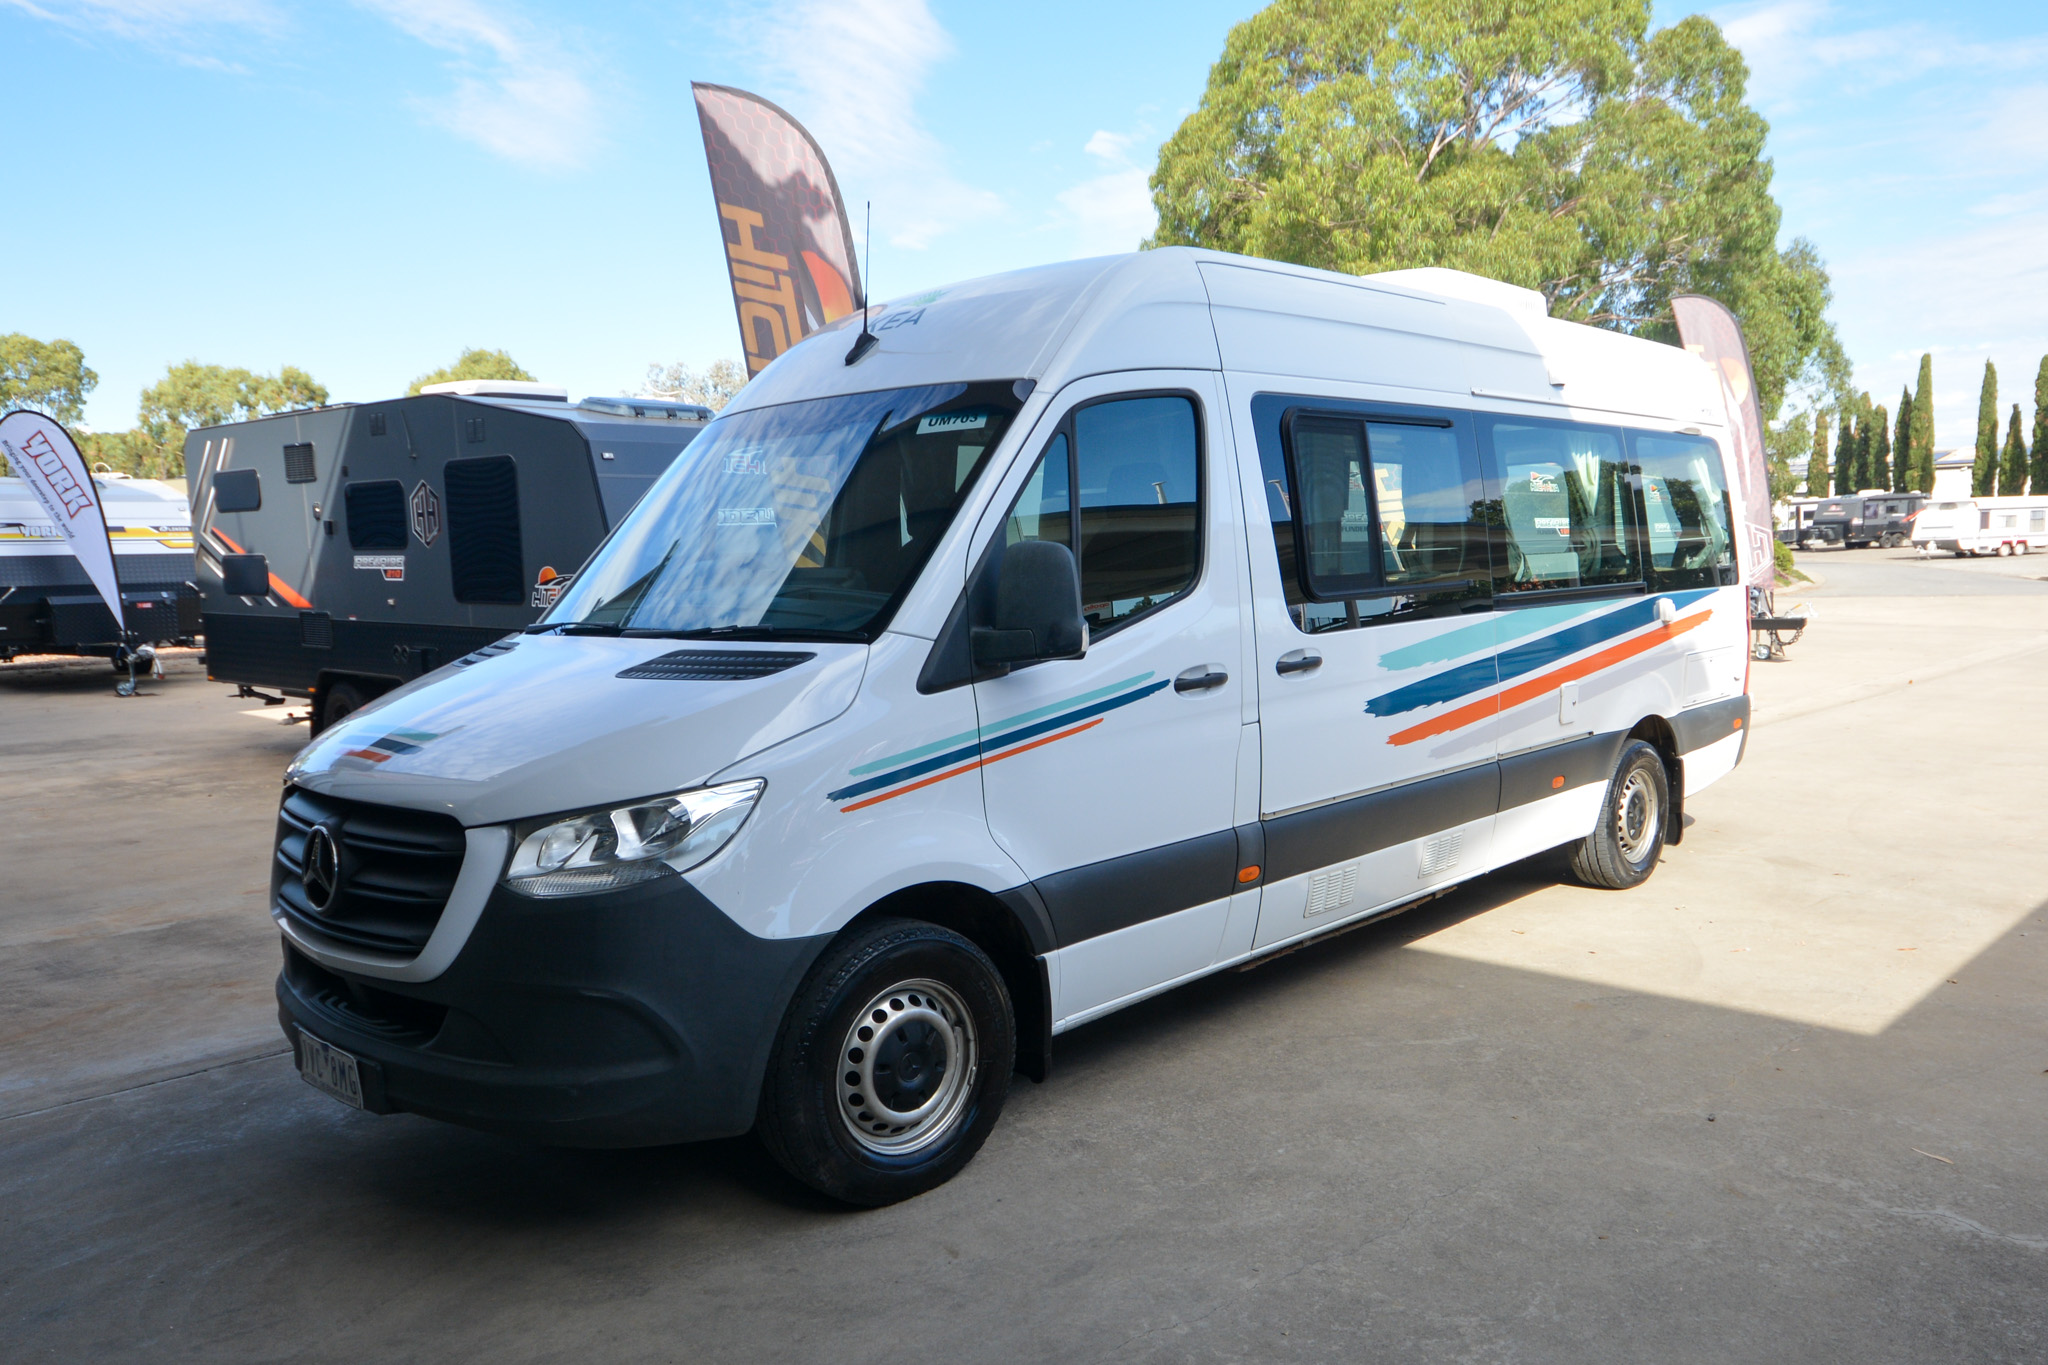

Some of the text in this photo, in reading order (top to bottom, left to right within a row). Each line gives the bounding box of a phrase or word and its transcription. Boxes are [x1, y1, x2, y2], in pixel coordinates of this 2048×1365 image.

[720, 202, 809, 372] HITC
[868, 308, 927, 333] KEA
[928, 413, 979, 427] UM703
[2, 439, 22, 465] Bringing
[18, 464, 32, 480] your
[30, 478, 50, 505] doorstep
[61, 522, 75, 539] world
[21, 429, 93, 519] YORK
